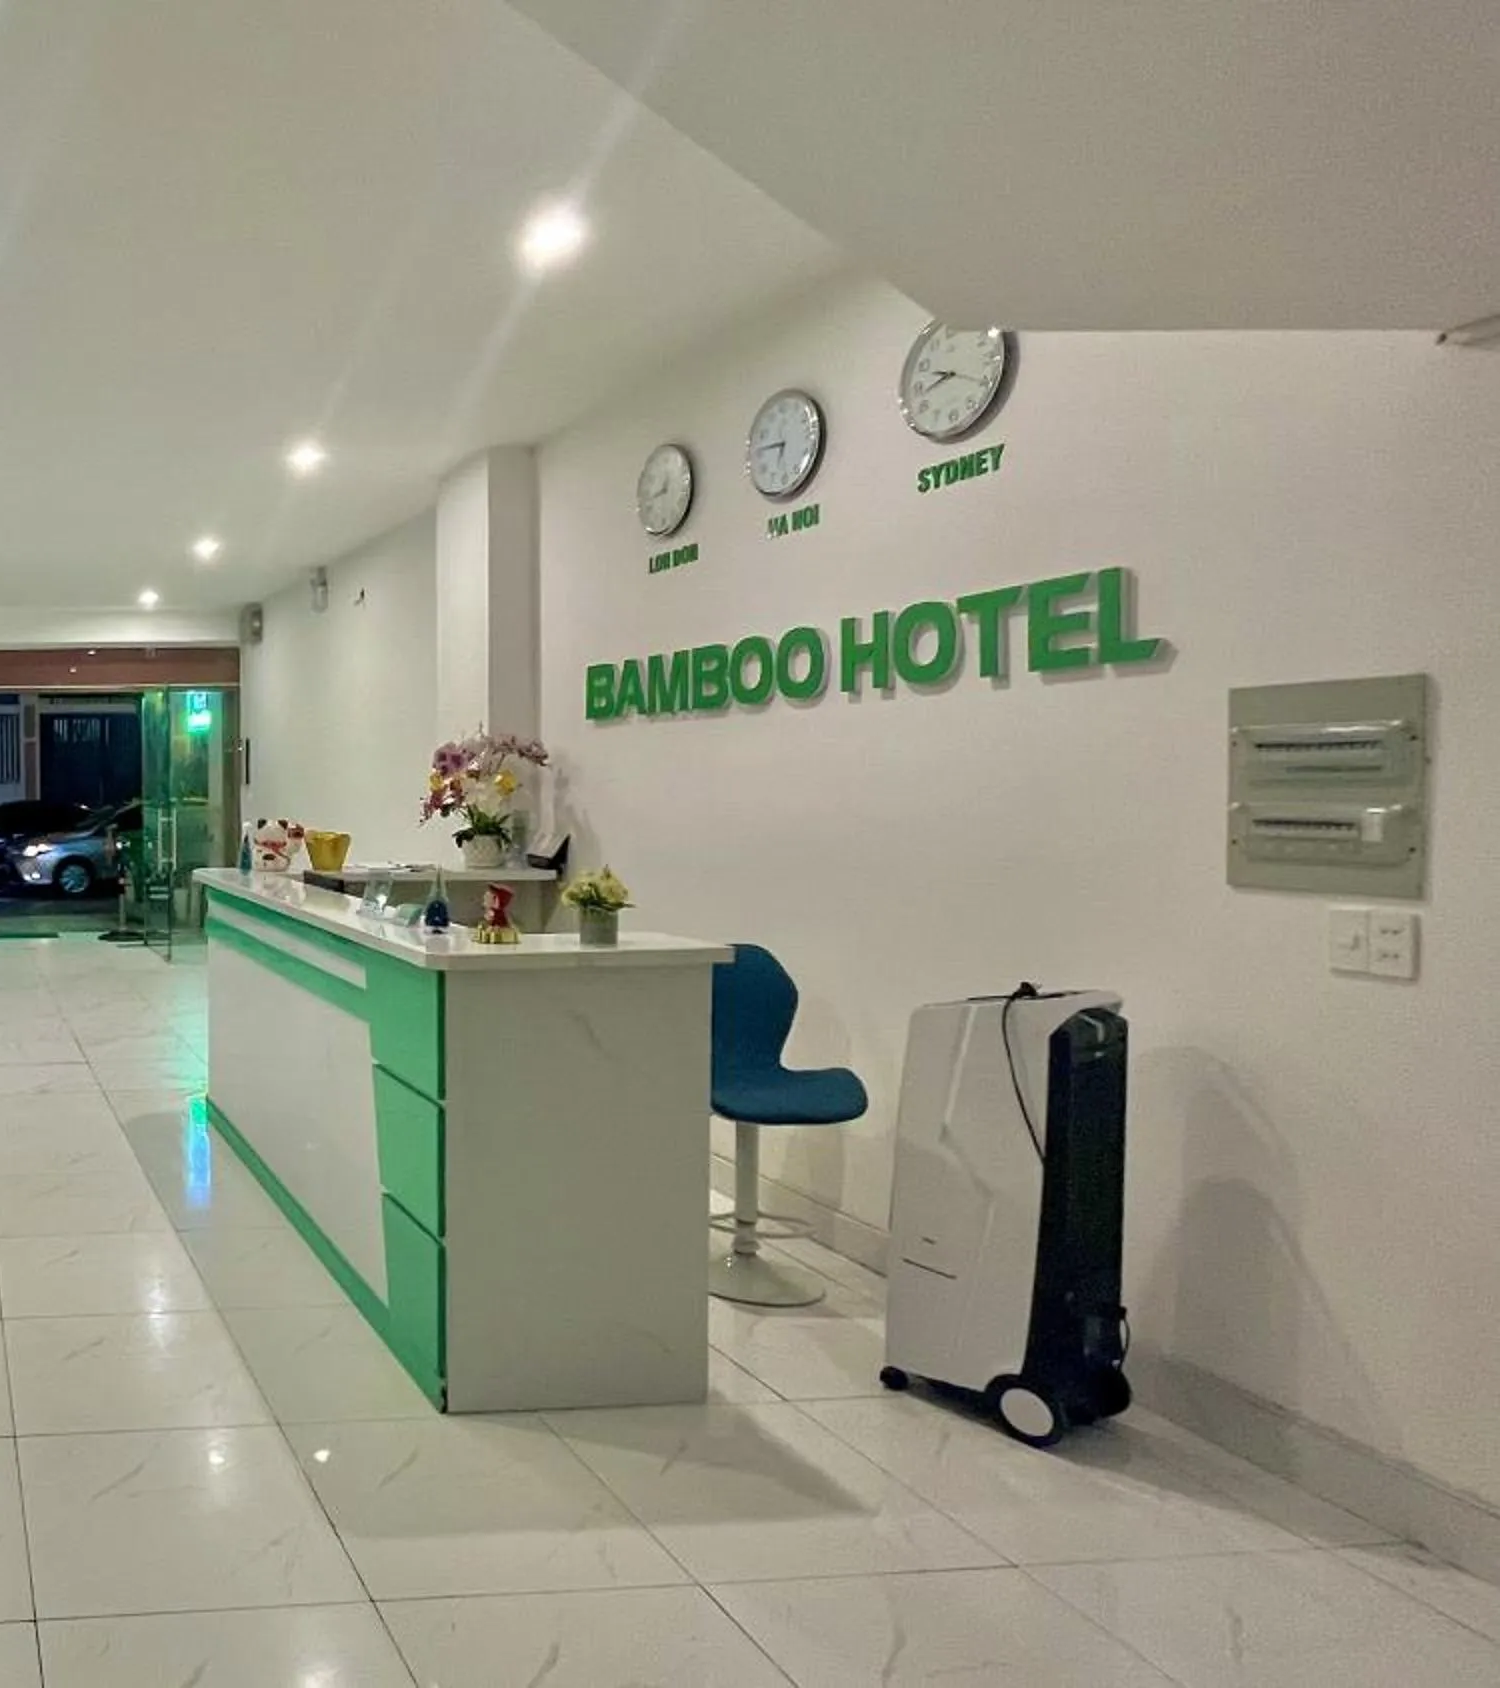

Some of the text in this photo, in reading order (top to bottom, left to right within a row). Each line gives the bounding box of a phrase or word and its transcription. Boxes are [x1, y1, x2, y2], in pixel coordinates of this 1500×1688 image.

[917, 443, 1005, 492] SYDNEY
[586, 567, 1161, 719] BAMBOO HOTEL
